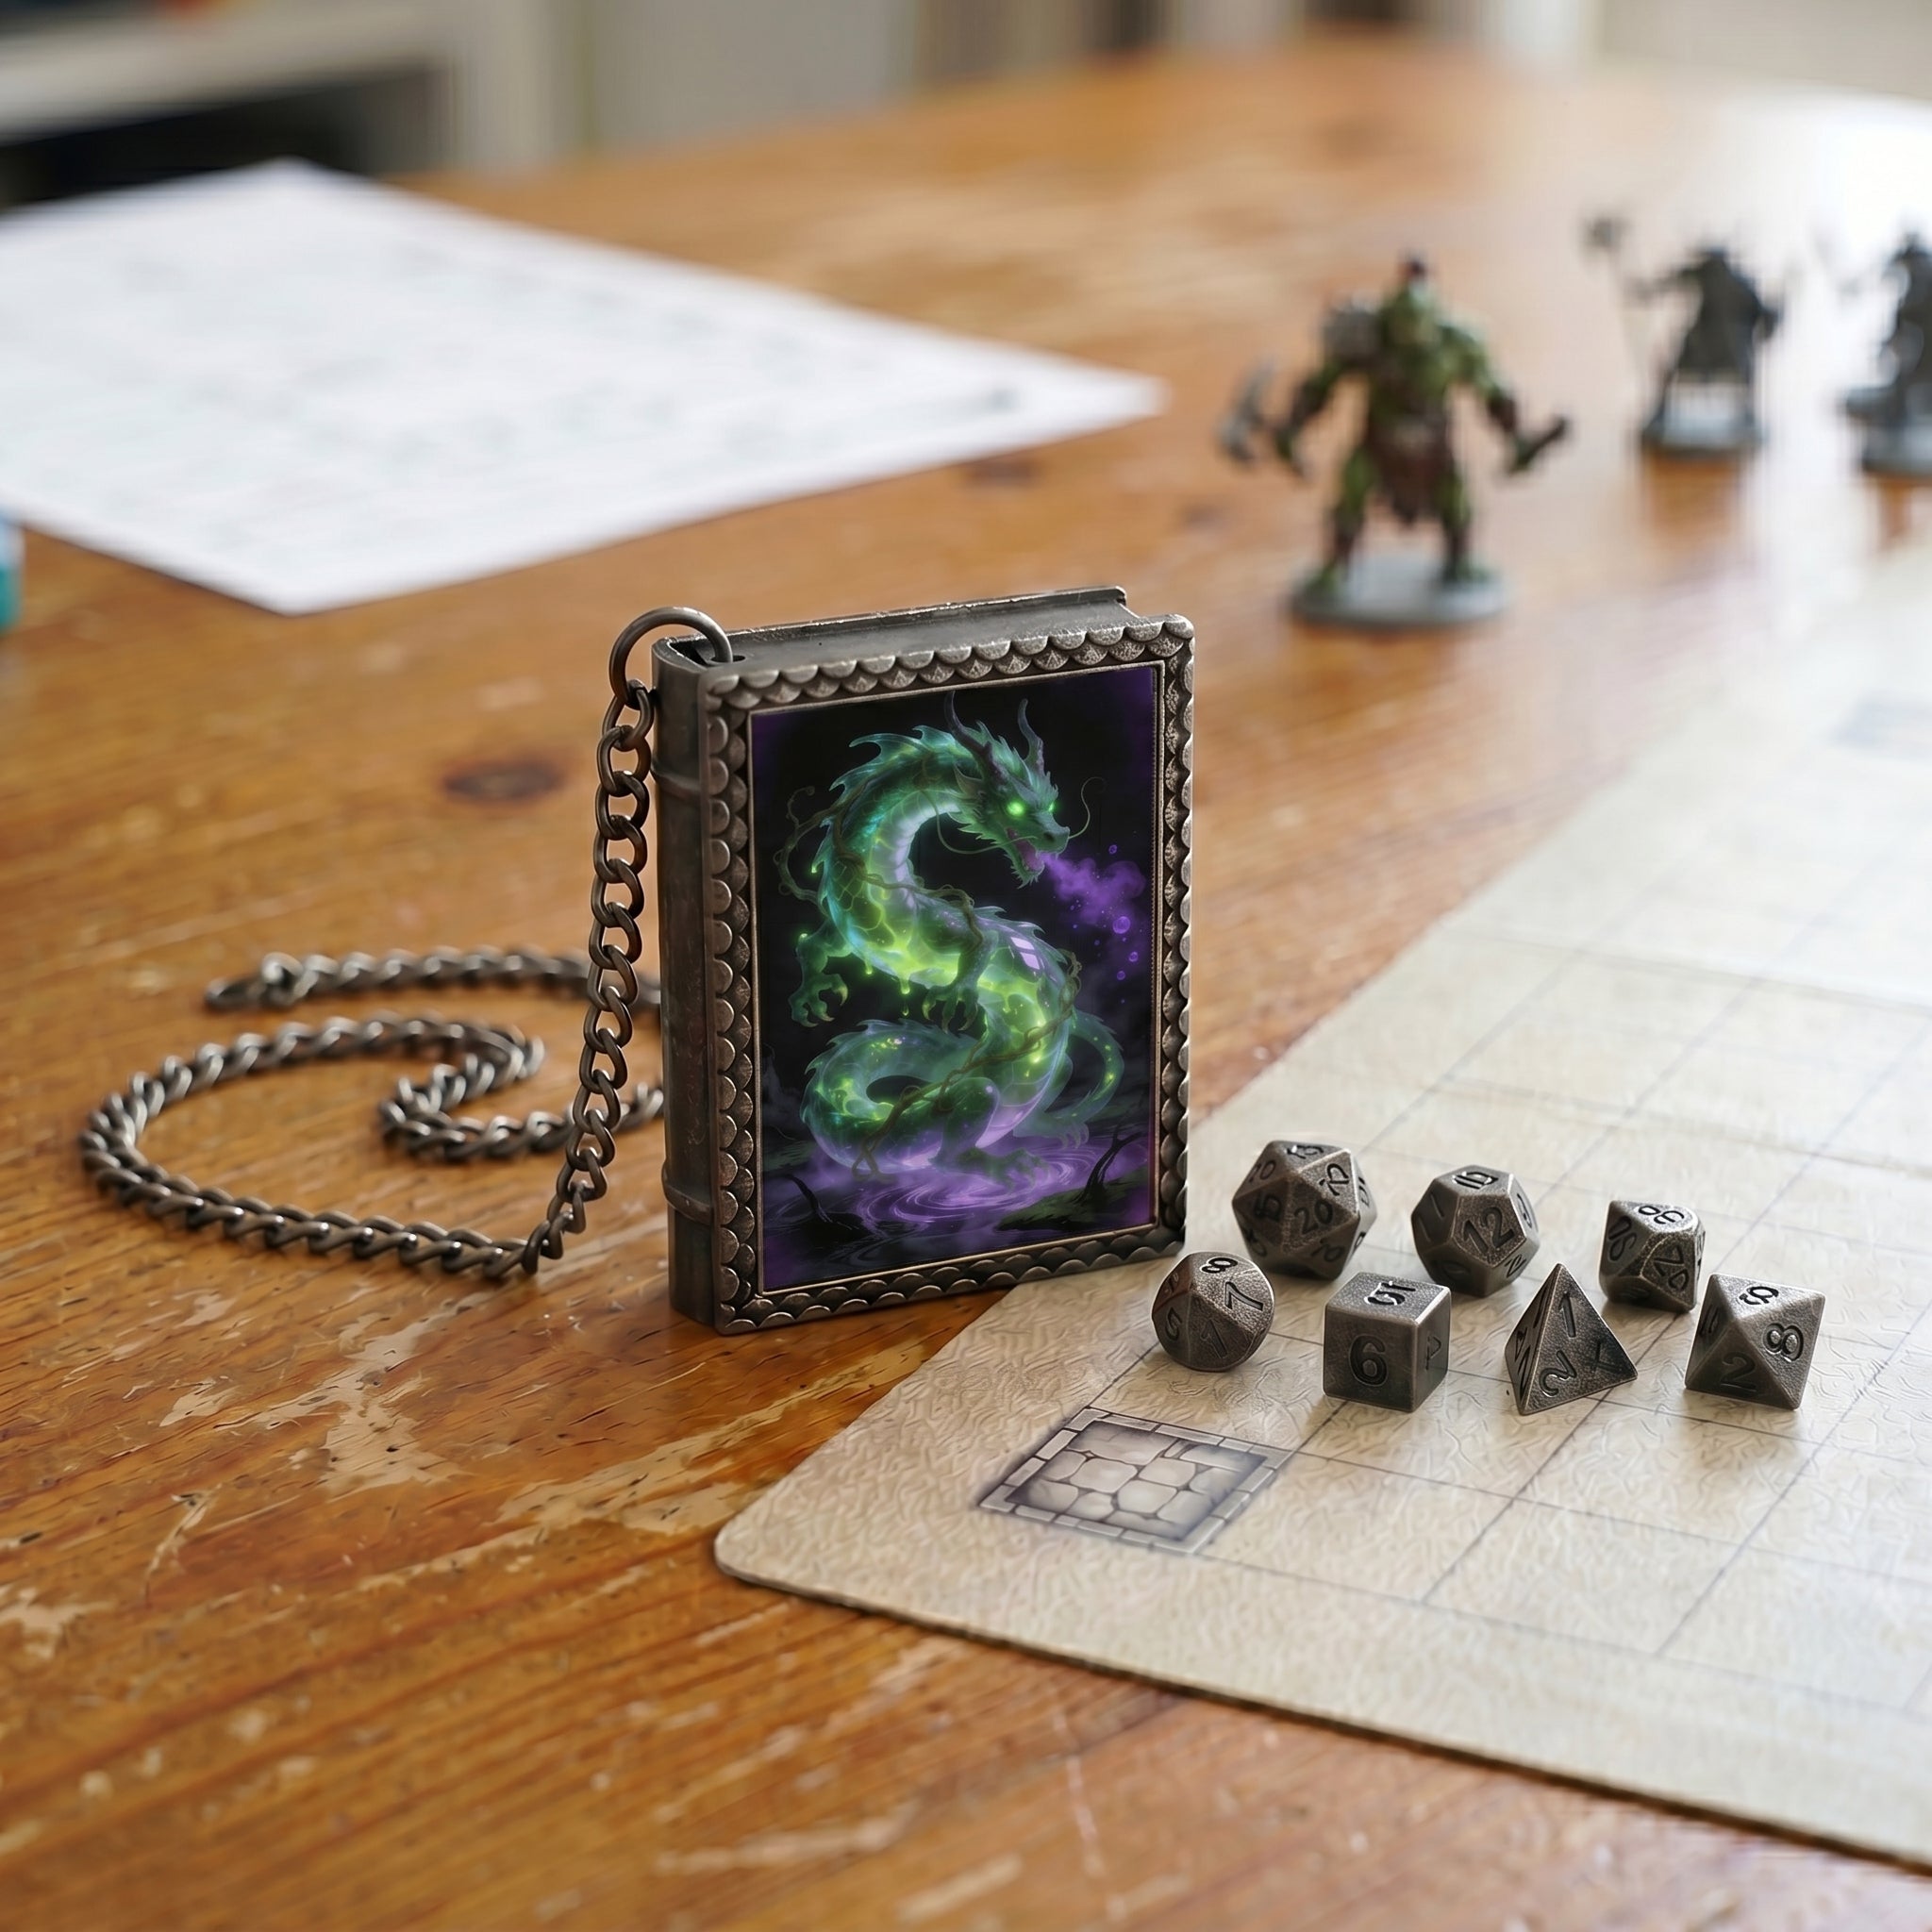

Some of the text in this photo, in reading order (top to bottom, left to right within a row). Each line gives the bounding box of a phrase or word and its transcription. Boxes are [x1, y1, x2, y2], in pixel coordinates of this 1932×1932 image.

[1295, 1201, 1334, 1235] 20
[1462, 1207, 1515, 1254] 12
[1558, 1292, 1576, 1338] 1
[1349, 1333, 1389, 1387] 6
[1761, 1322, 1804, 1362] 8
[1720, 1352, 1757, 1391] 2
